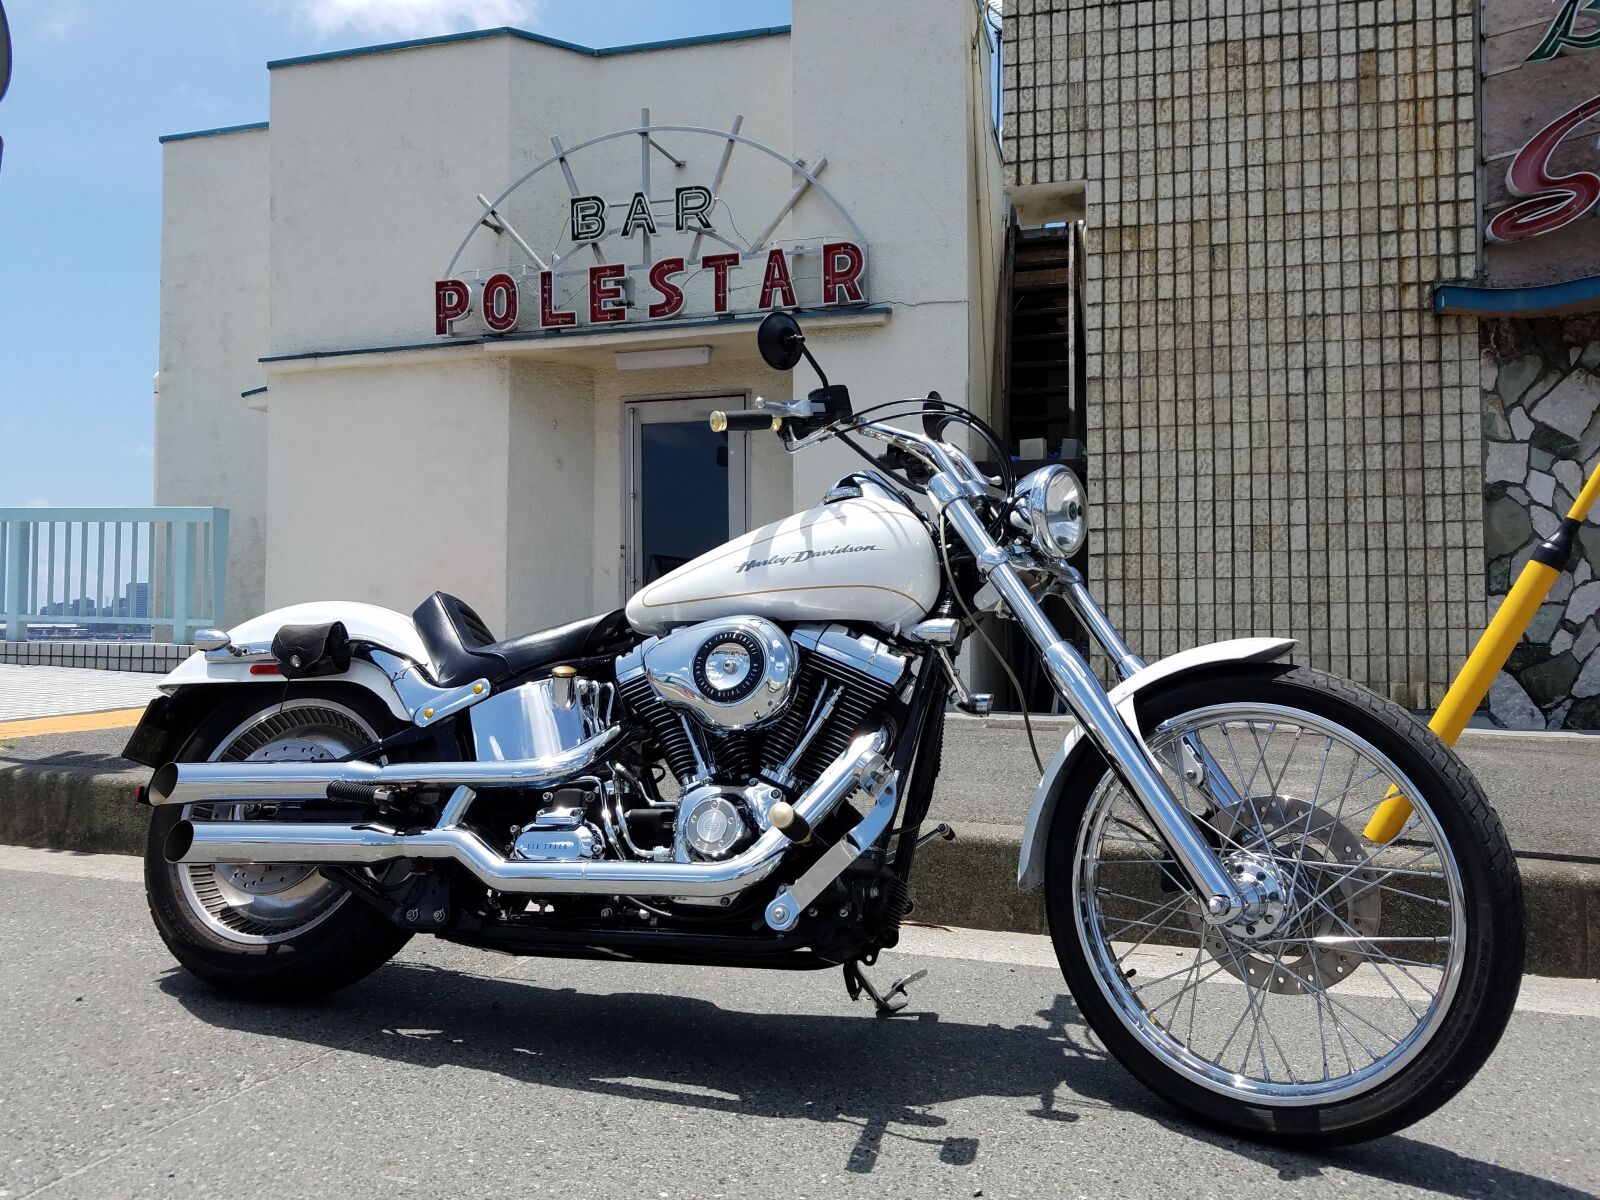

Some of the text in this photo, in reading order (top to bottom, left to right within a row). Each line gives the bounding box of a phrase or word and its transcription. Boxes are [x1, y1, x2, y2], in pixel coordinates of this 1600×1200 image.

[570, 185, 717, 243] BAR
[434, 241, 867, 336] POLESTAR
[733, 543, 885, 574] Harley-Davidson
